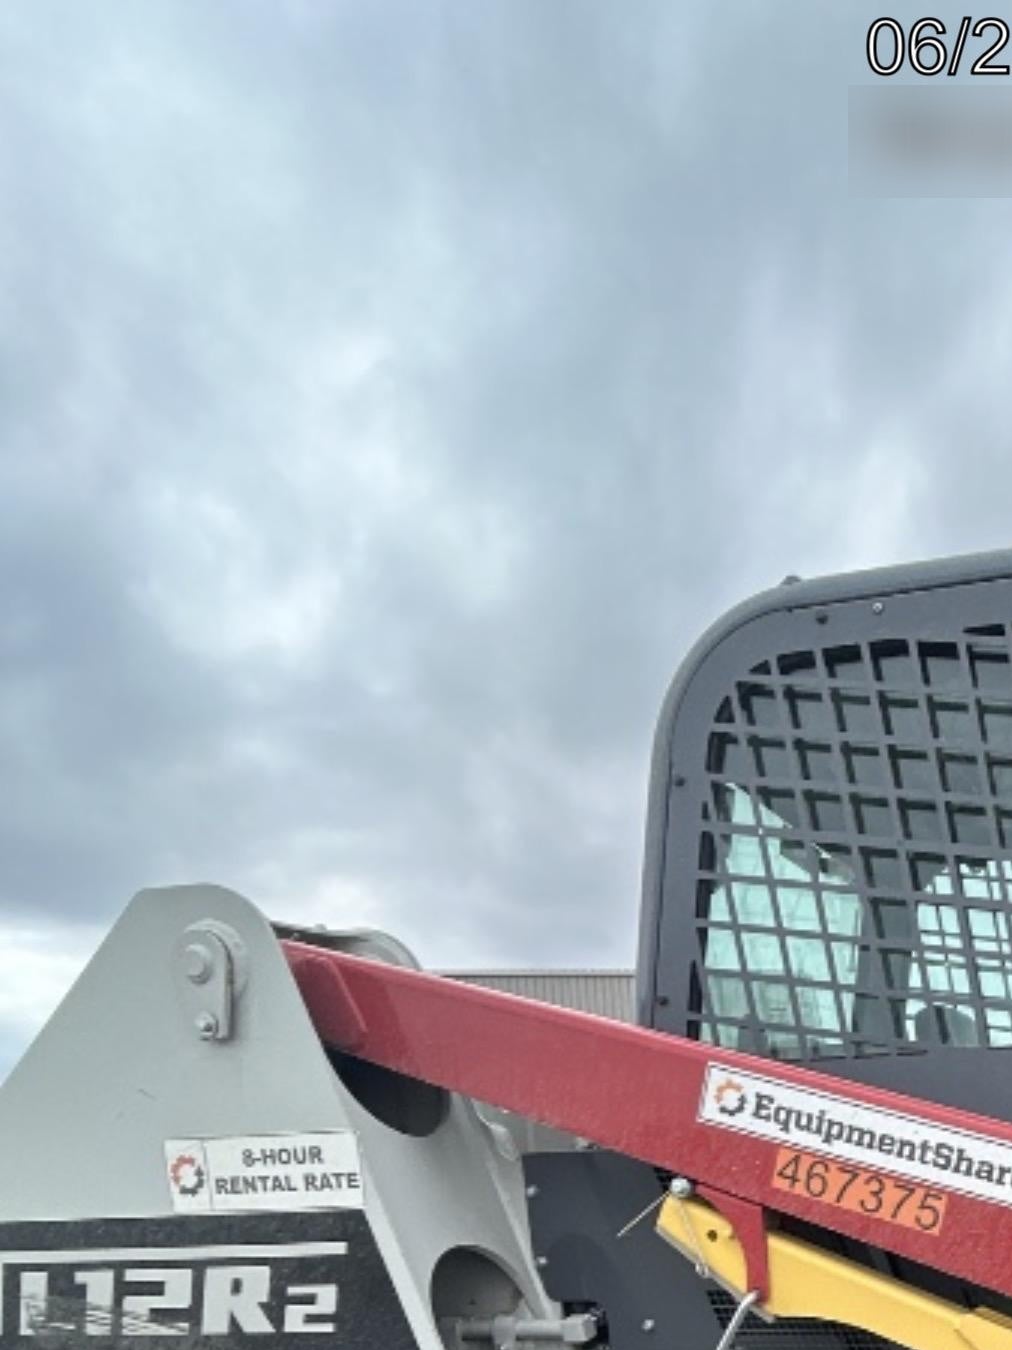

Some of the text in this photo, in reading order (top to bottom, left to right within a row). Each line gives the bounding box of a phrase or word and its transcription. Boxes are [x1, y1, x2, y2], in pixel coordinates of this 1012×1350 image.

[242, 1146, 325, 1168] 8-HOUR
[214, 1172, 361, 1195] RENTAL RATE
[777, 1153, 943, 1232] 467375
